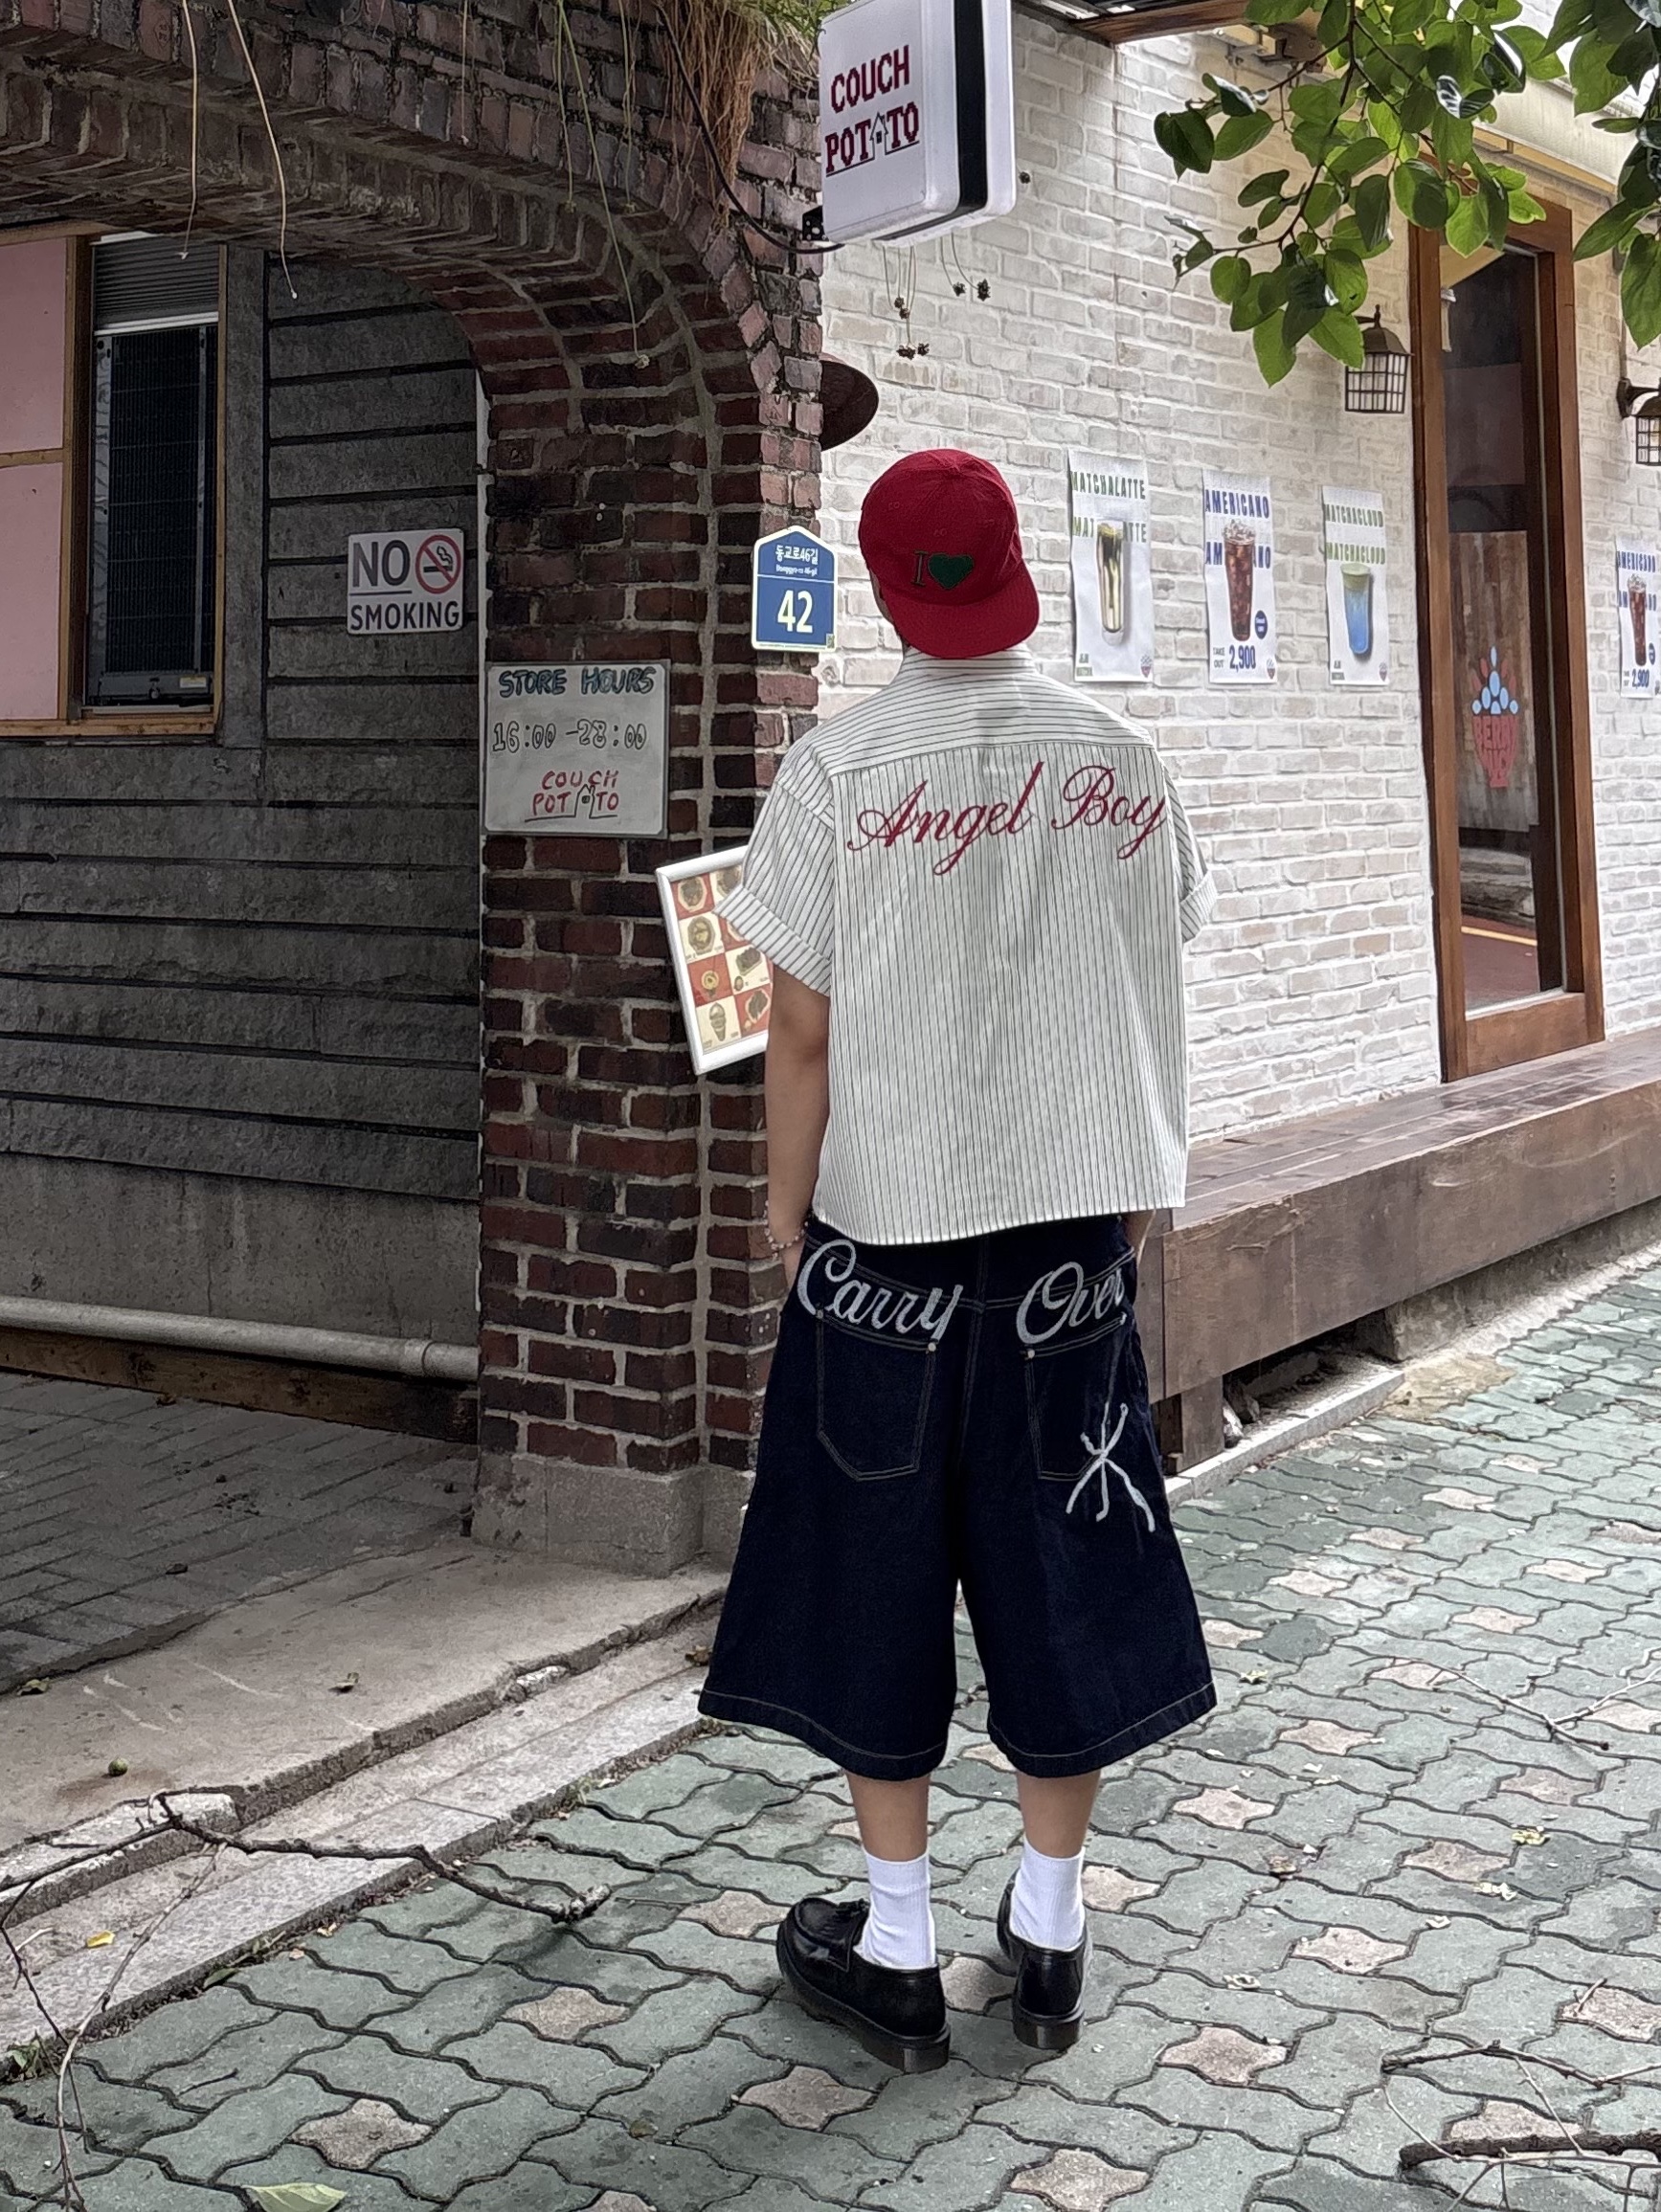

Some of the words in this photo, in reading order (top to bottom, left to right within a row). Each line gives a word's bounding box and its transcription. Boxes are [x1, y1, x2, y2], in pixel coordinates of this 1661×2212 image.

[831, 45, 909, 113] COUCH
[1205, 489, 1269, 519] AMERICANO
[352, 540, 411, 588] NO
[775, 545, 819, 566] 동교로46길
[911, 550, 928, 587] I
[350, 600, 460, 631] SMOKING
[777, 590, 813, 633] 42
[1229, 644, 1256, 672] 2,900
[499, 667, 568, 698] STORE
[581, 666, 657, 695] HOURS
[542, 770, 618, 791] COUCH
[847, 761, 1044, 876] Angel
[1051, 765, 1169, 860] Boy
[797, 1239, 963, 1344] Carry
